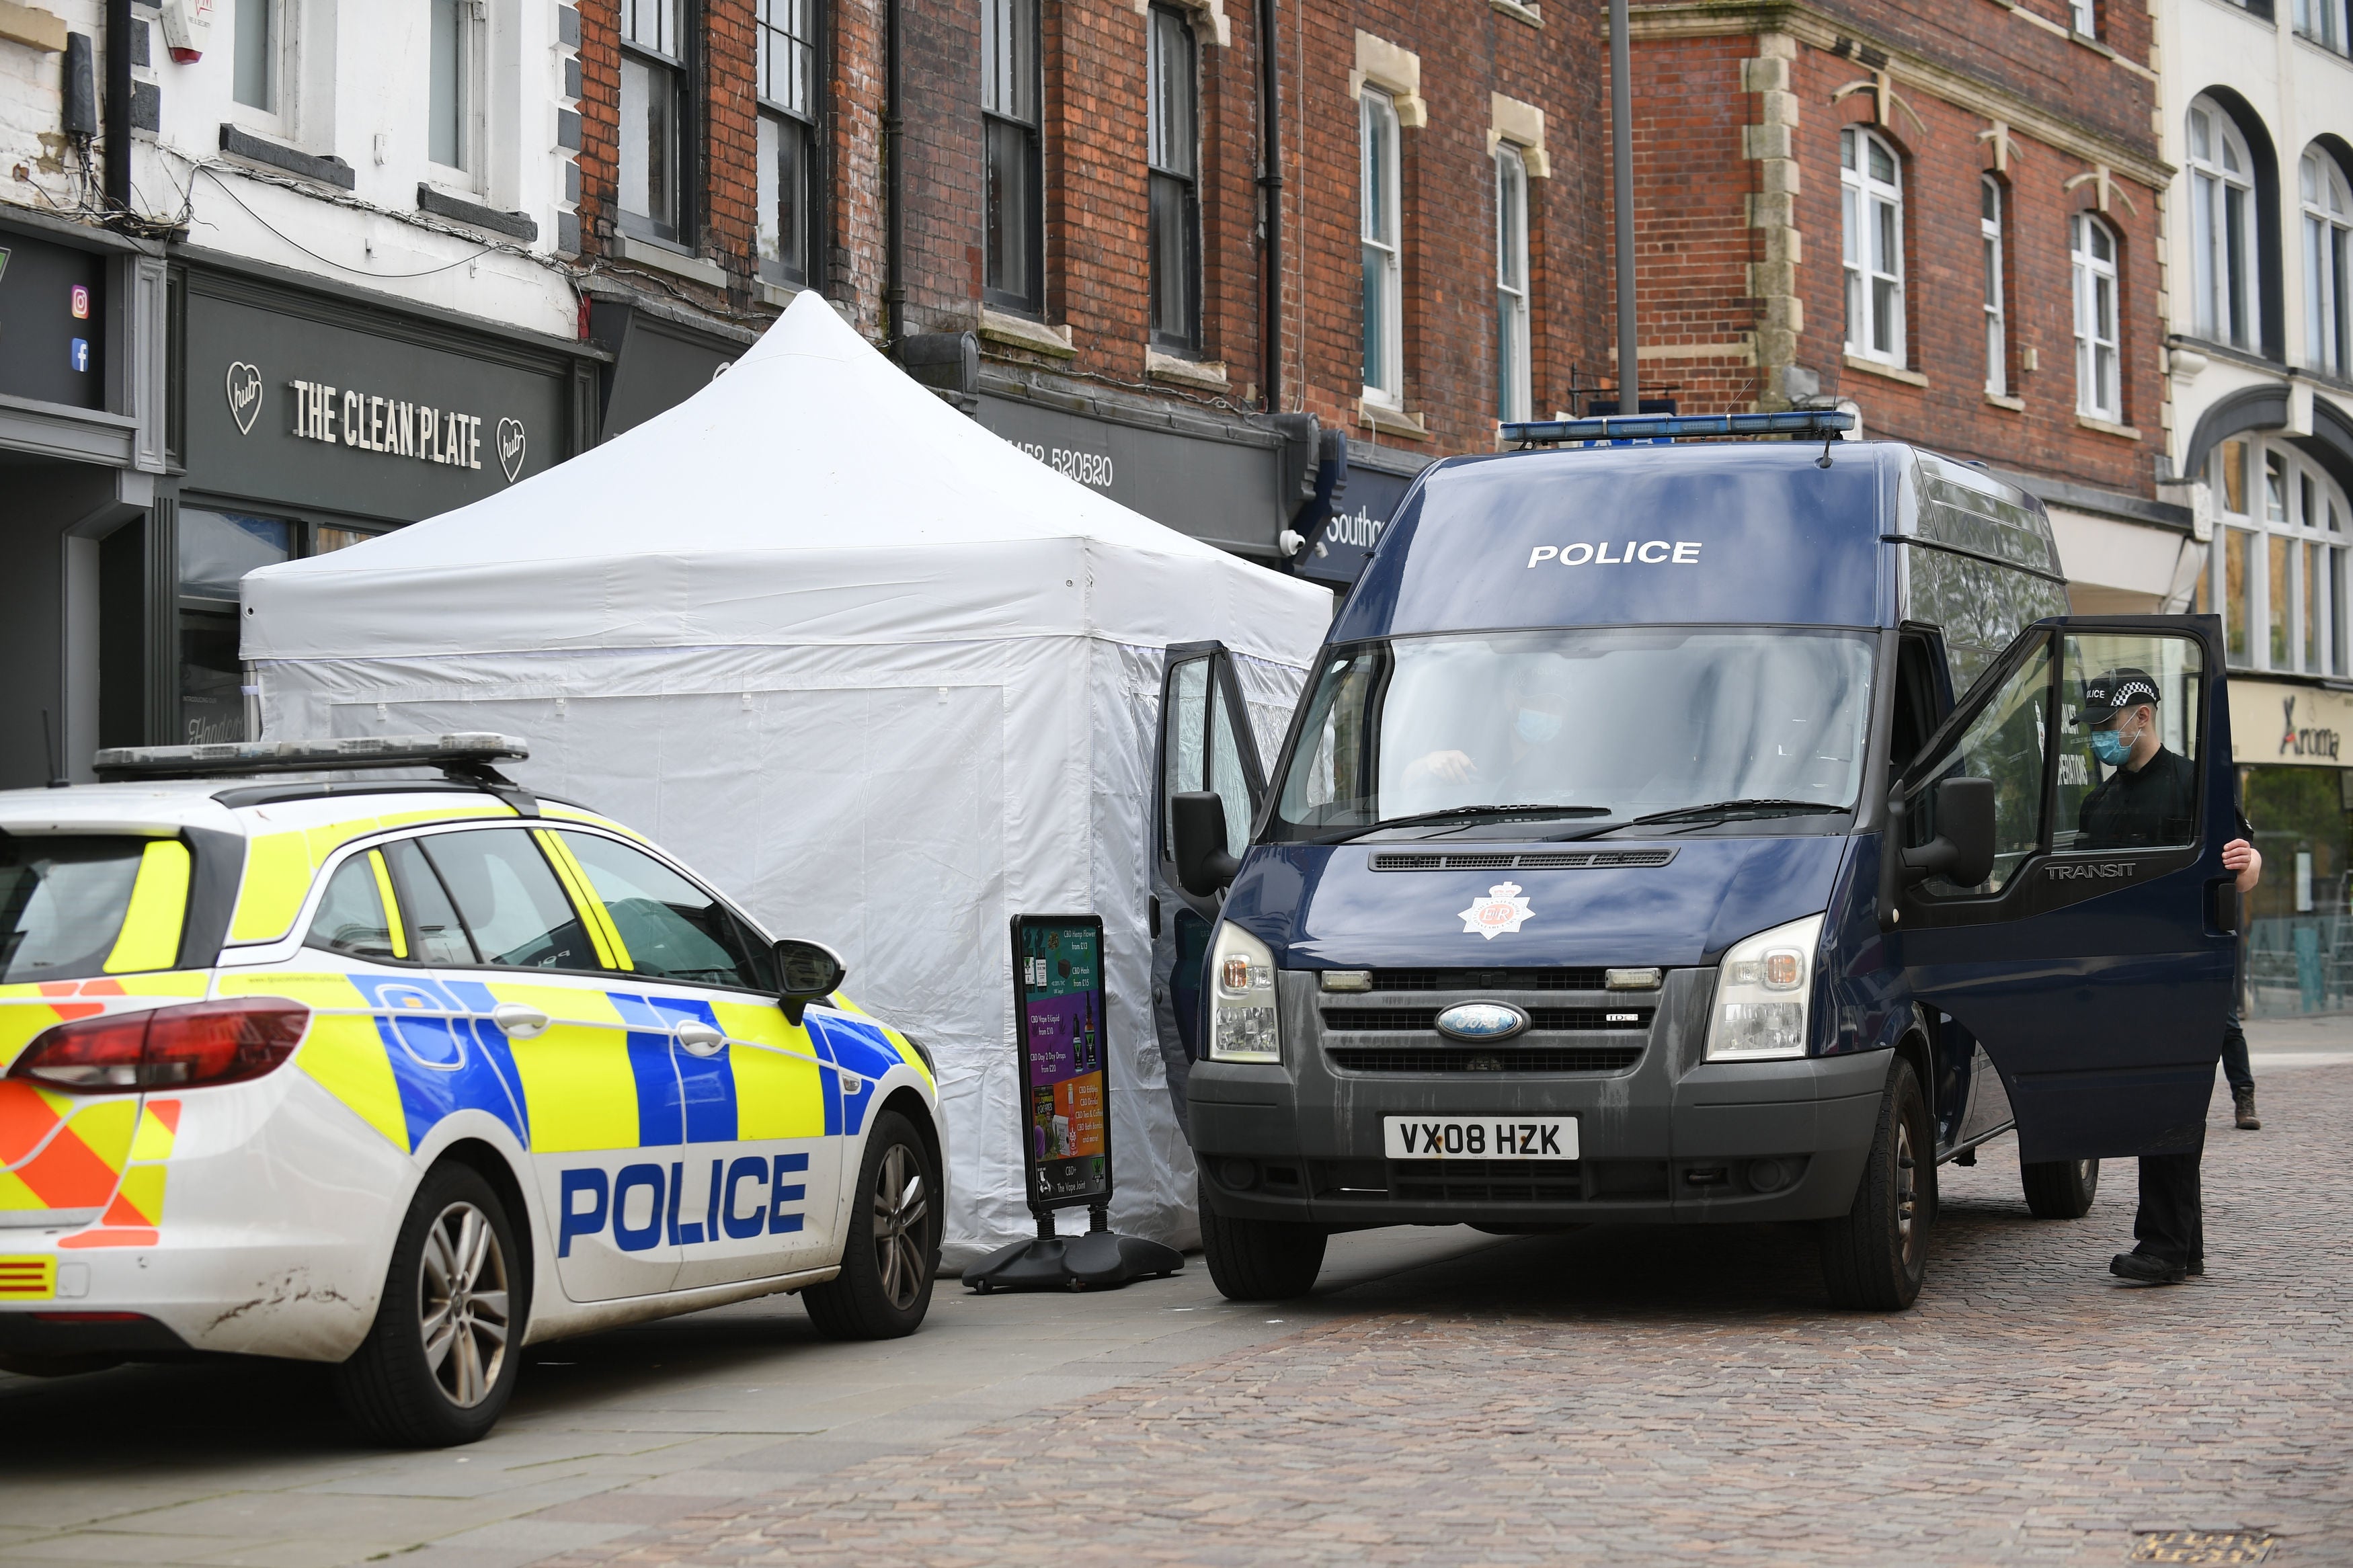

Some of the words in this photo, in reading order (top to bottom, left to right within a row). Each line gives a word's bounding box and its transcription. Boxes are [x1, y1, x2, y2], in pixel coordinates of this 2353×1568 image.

[235, 374, 261, 411] hub
[294, 380, 336, 443] THE
[344, 390, 413, 456] CLEAN
[420, 406, 481, 470] PLATE
[502, 428, 524, 462] hub
[1051, 448, 1113, 487] 520520
[1527, 540, 1702, 569] POLICE
[2280, 695, 2340, 761] Aroma
[2057, 753, 2088, 786] PERATIONS
[2044, 863, 2137, 880] TRANSIT
[1072, 930, 1082, 939] Hemp
[1083, 930, 1095, 938] Flower
[1080, 966, 1089, 974] Hash
[1038, 1015, 1047, 1024] Vape
[1041, 1065, 1049, 1073] from
[1055, 1052, 1066, 1061] Drops
[1400, 1124, 1486, 1154] VX08
[1496, 1124, 1561, 1155] HZK
[1066, 1166, 1076, 1175] CBD+
[1066, 1182, 1076, 1194] Vape
[1076, 1180, 1086, 1190] Joint
[558, 1152, 809, 1258] POLICE
